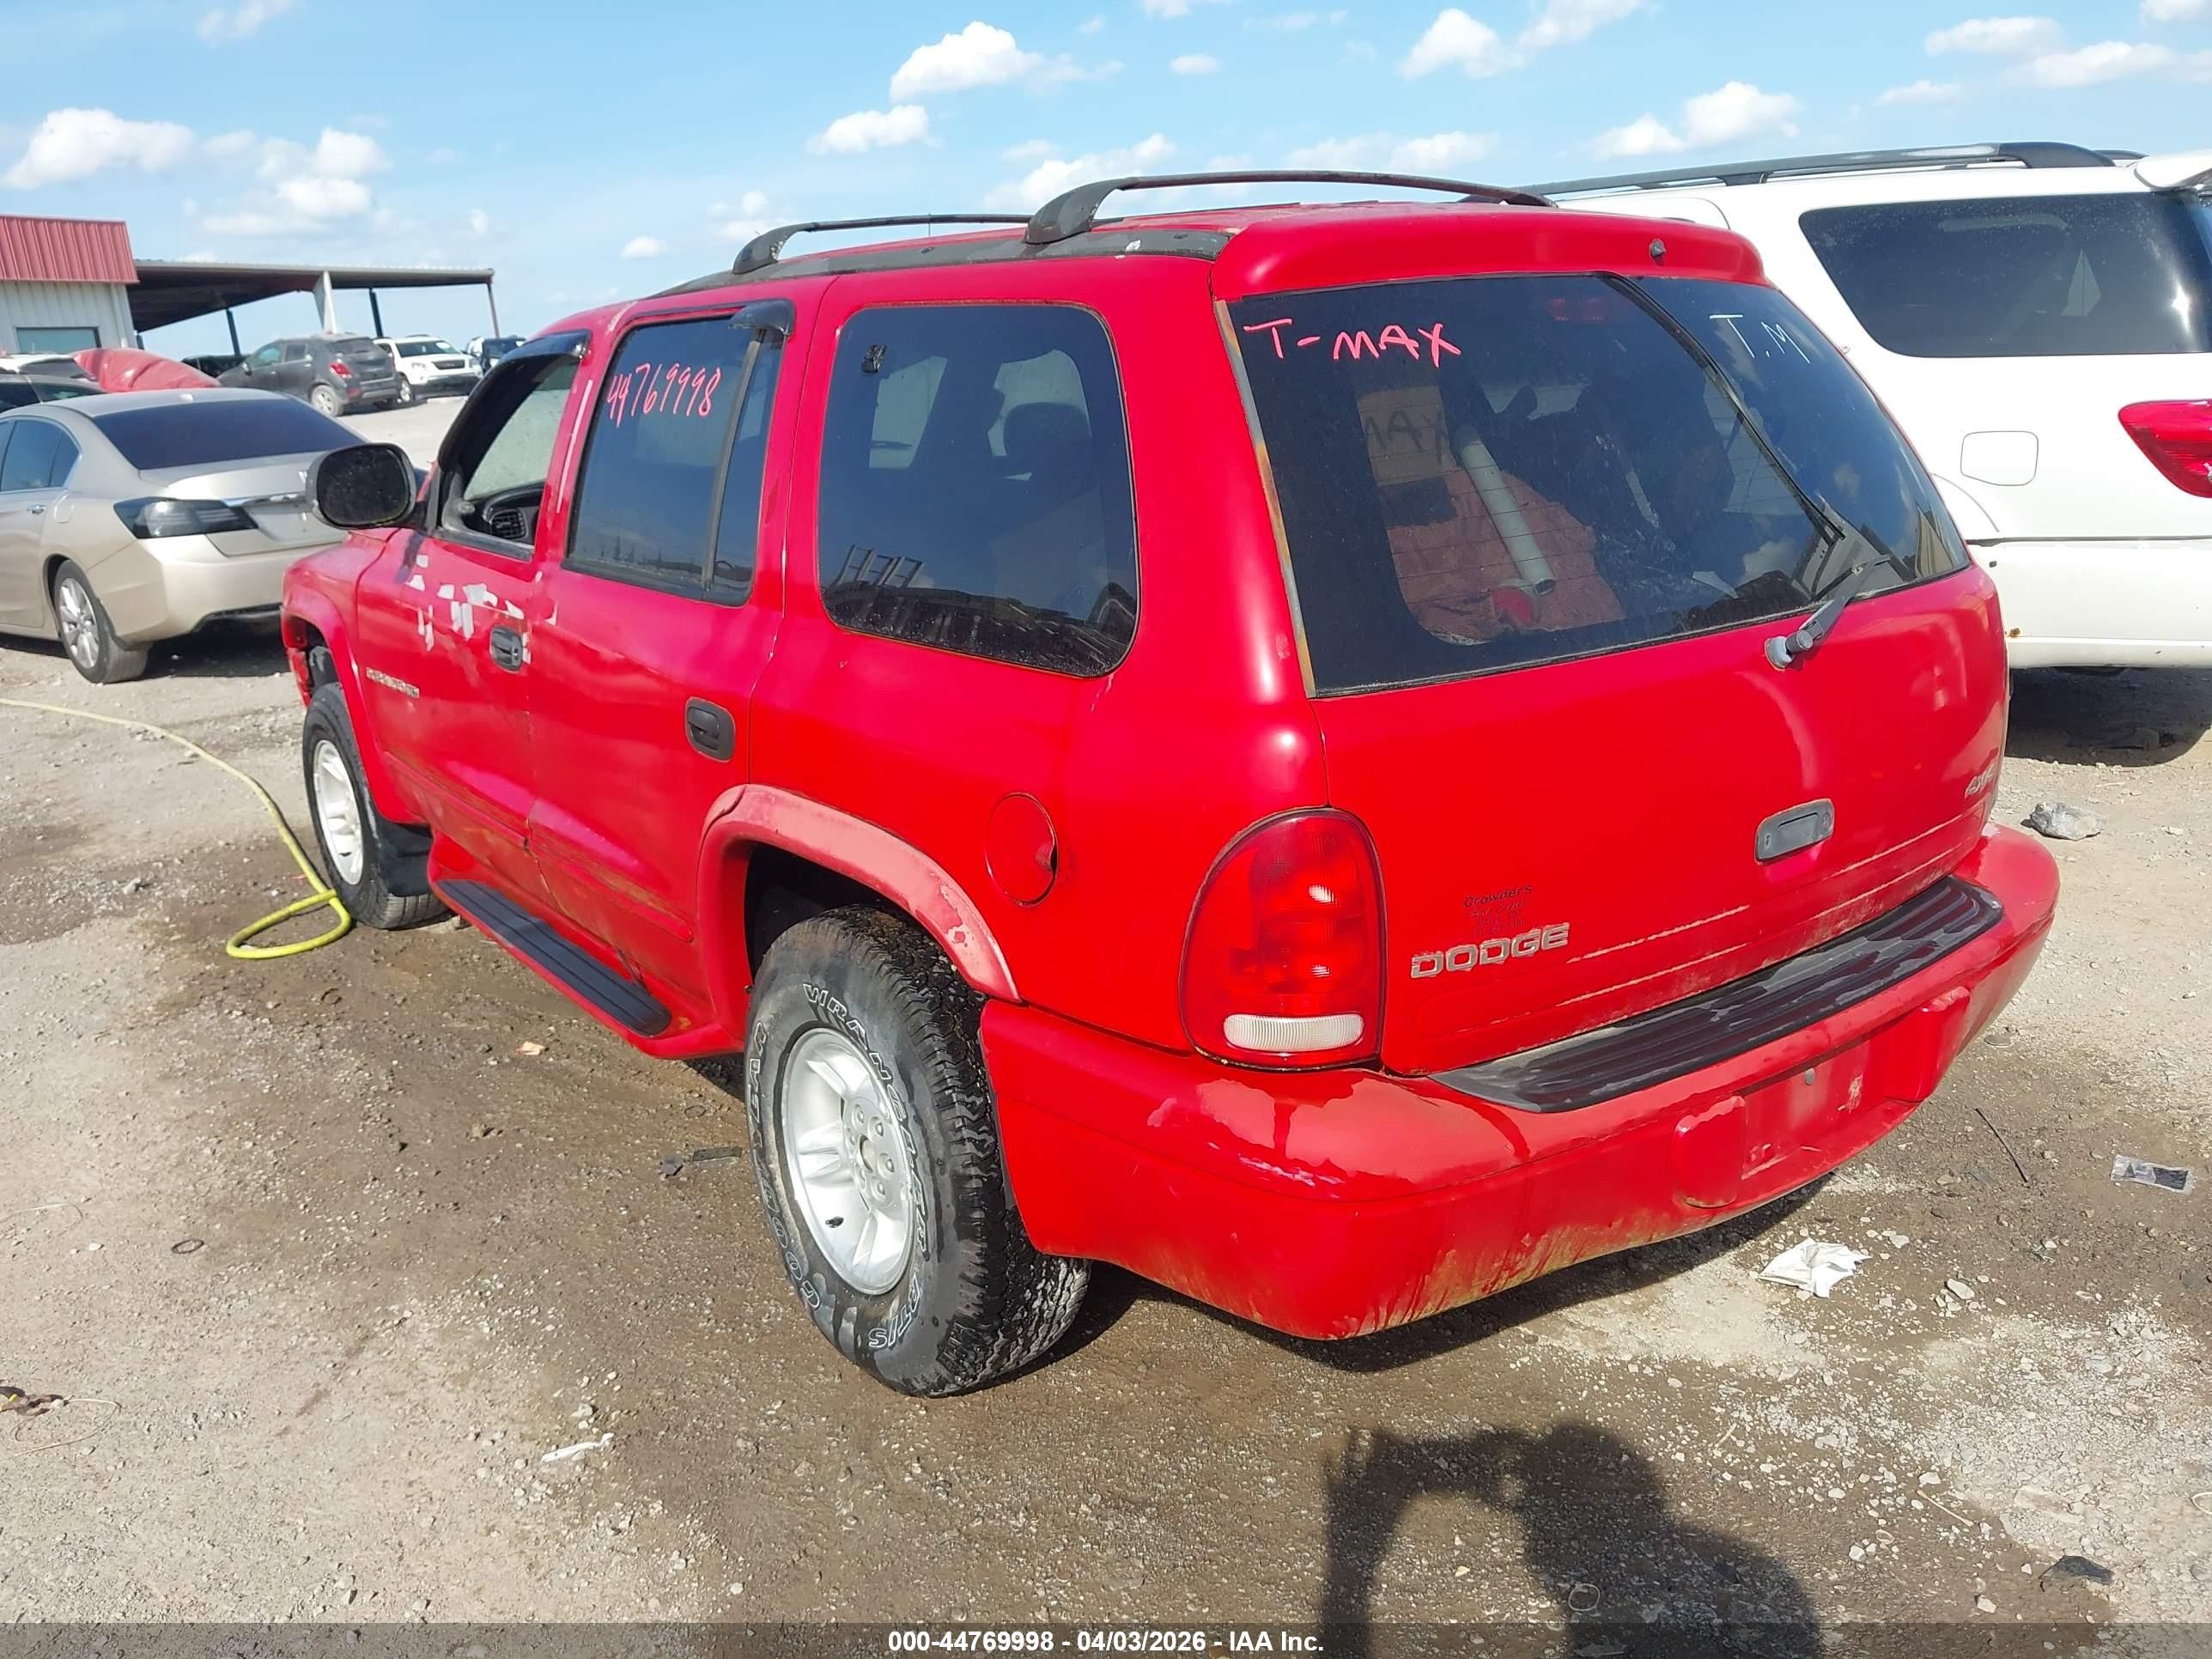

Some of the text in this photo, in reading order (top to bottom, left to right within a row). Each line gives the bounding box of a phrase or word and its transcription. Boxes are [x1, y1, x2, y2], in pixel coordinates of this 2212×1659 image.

[1243, 318, 1462, 368] T-MAX
[606, 362, 721, 428] 44769998
[1411, 922, 1570, 979] DODGE
[802, 982, 927, 1254] WRANGLER
